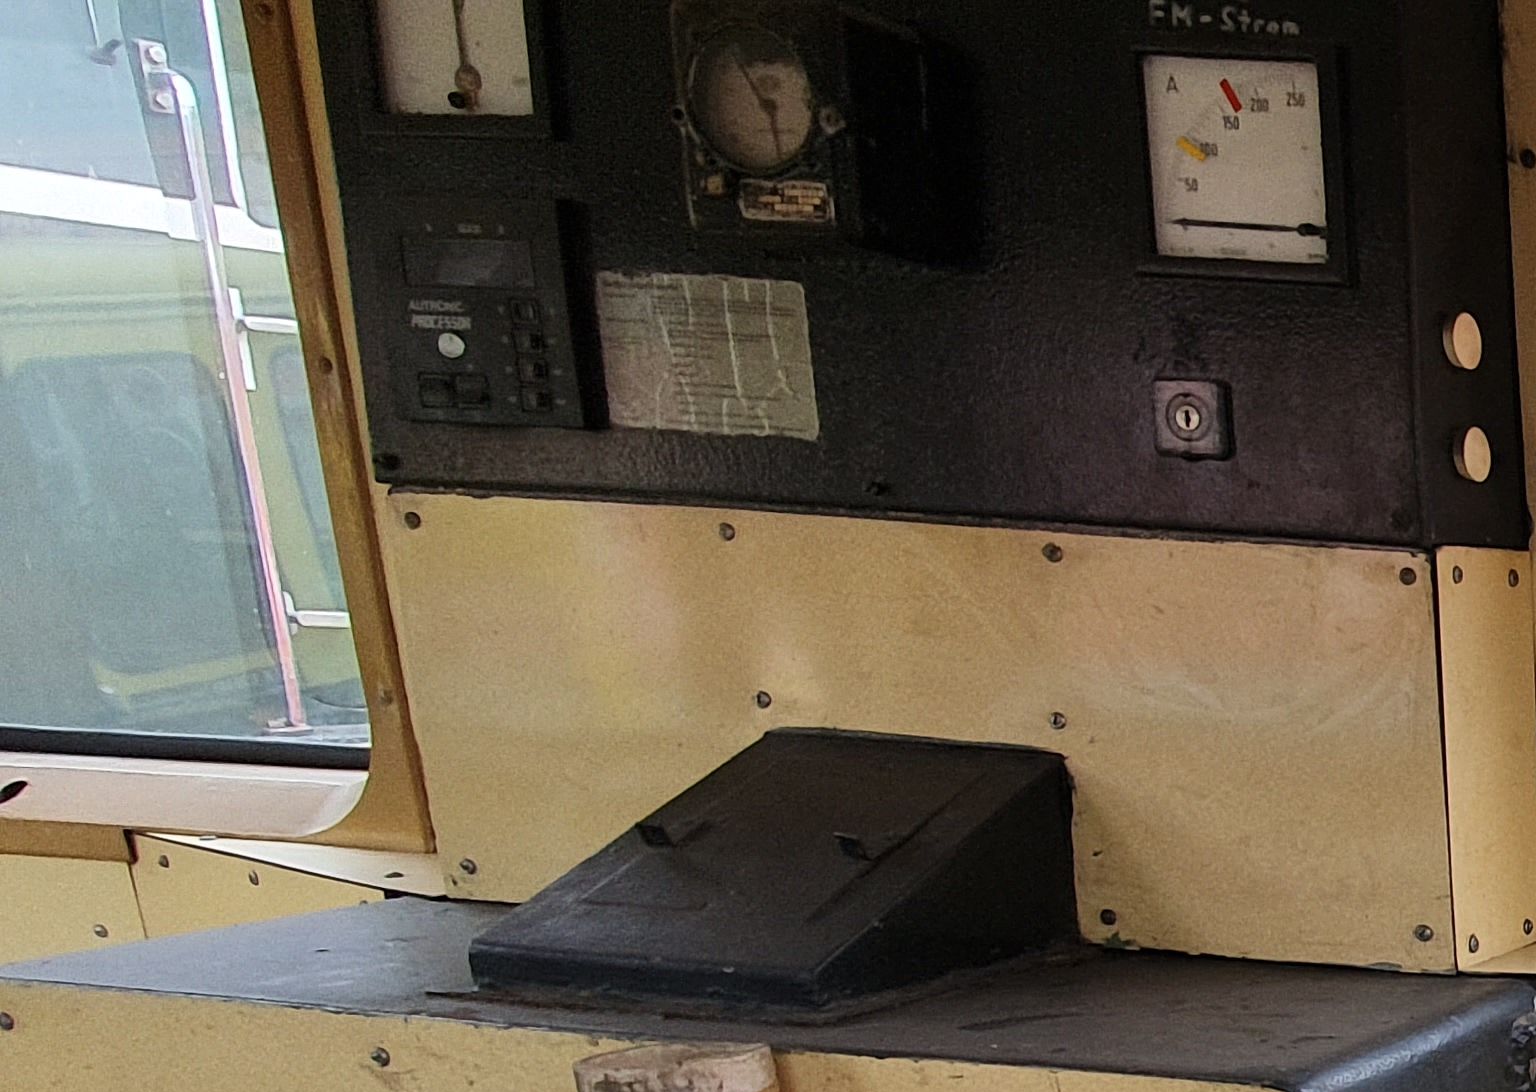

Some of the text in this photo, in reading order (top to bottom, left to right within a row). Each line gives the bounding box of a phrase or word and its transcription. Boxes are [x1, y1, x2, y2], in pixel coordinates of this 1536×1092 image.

[1166, 76, 1179, 93] A
[1251, 98, 1270, 113] 200
[1286, 92, 1306, 107] 250
[1223, 116, 1240, 130] 150
[1185, 178, 1199, 191] 50
